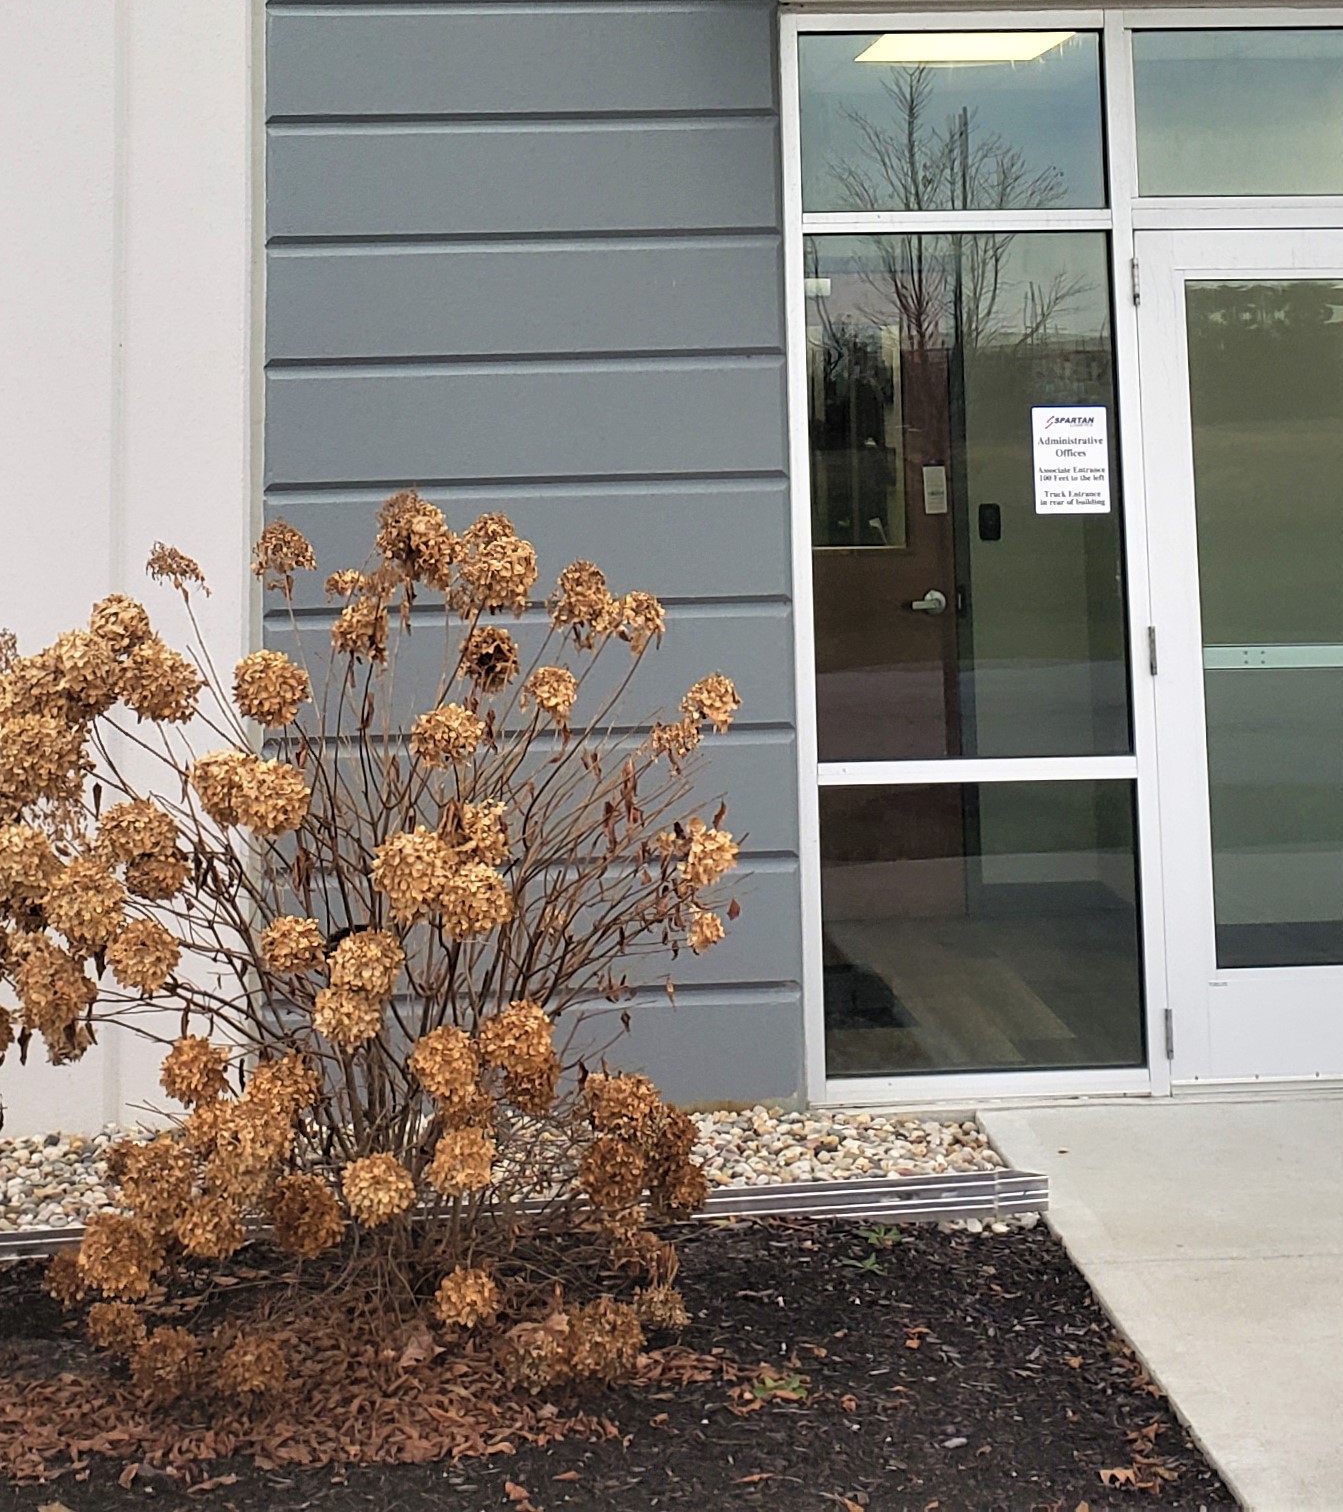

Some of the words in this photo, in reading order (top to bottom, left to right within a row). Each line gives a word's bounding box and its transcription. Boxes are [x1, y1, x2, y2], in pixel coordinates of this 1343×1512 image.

[1037, 436, 1104, 445] Administrative
[1055, 448, 1087, 457] Offices
[1076, 498, 1106, 506] building
